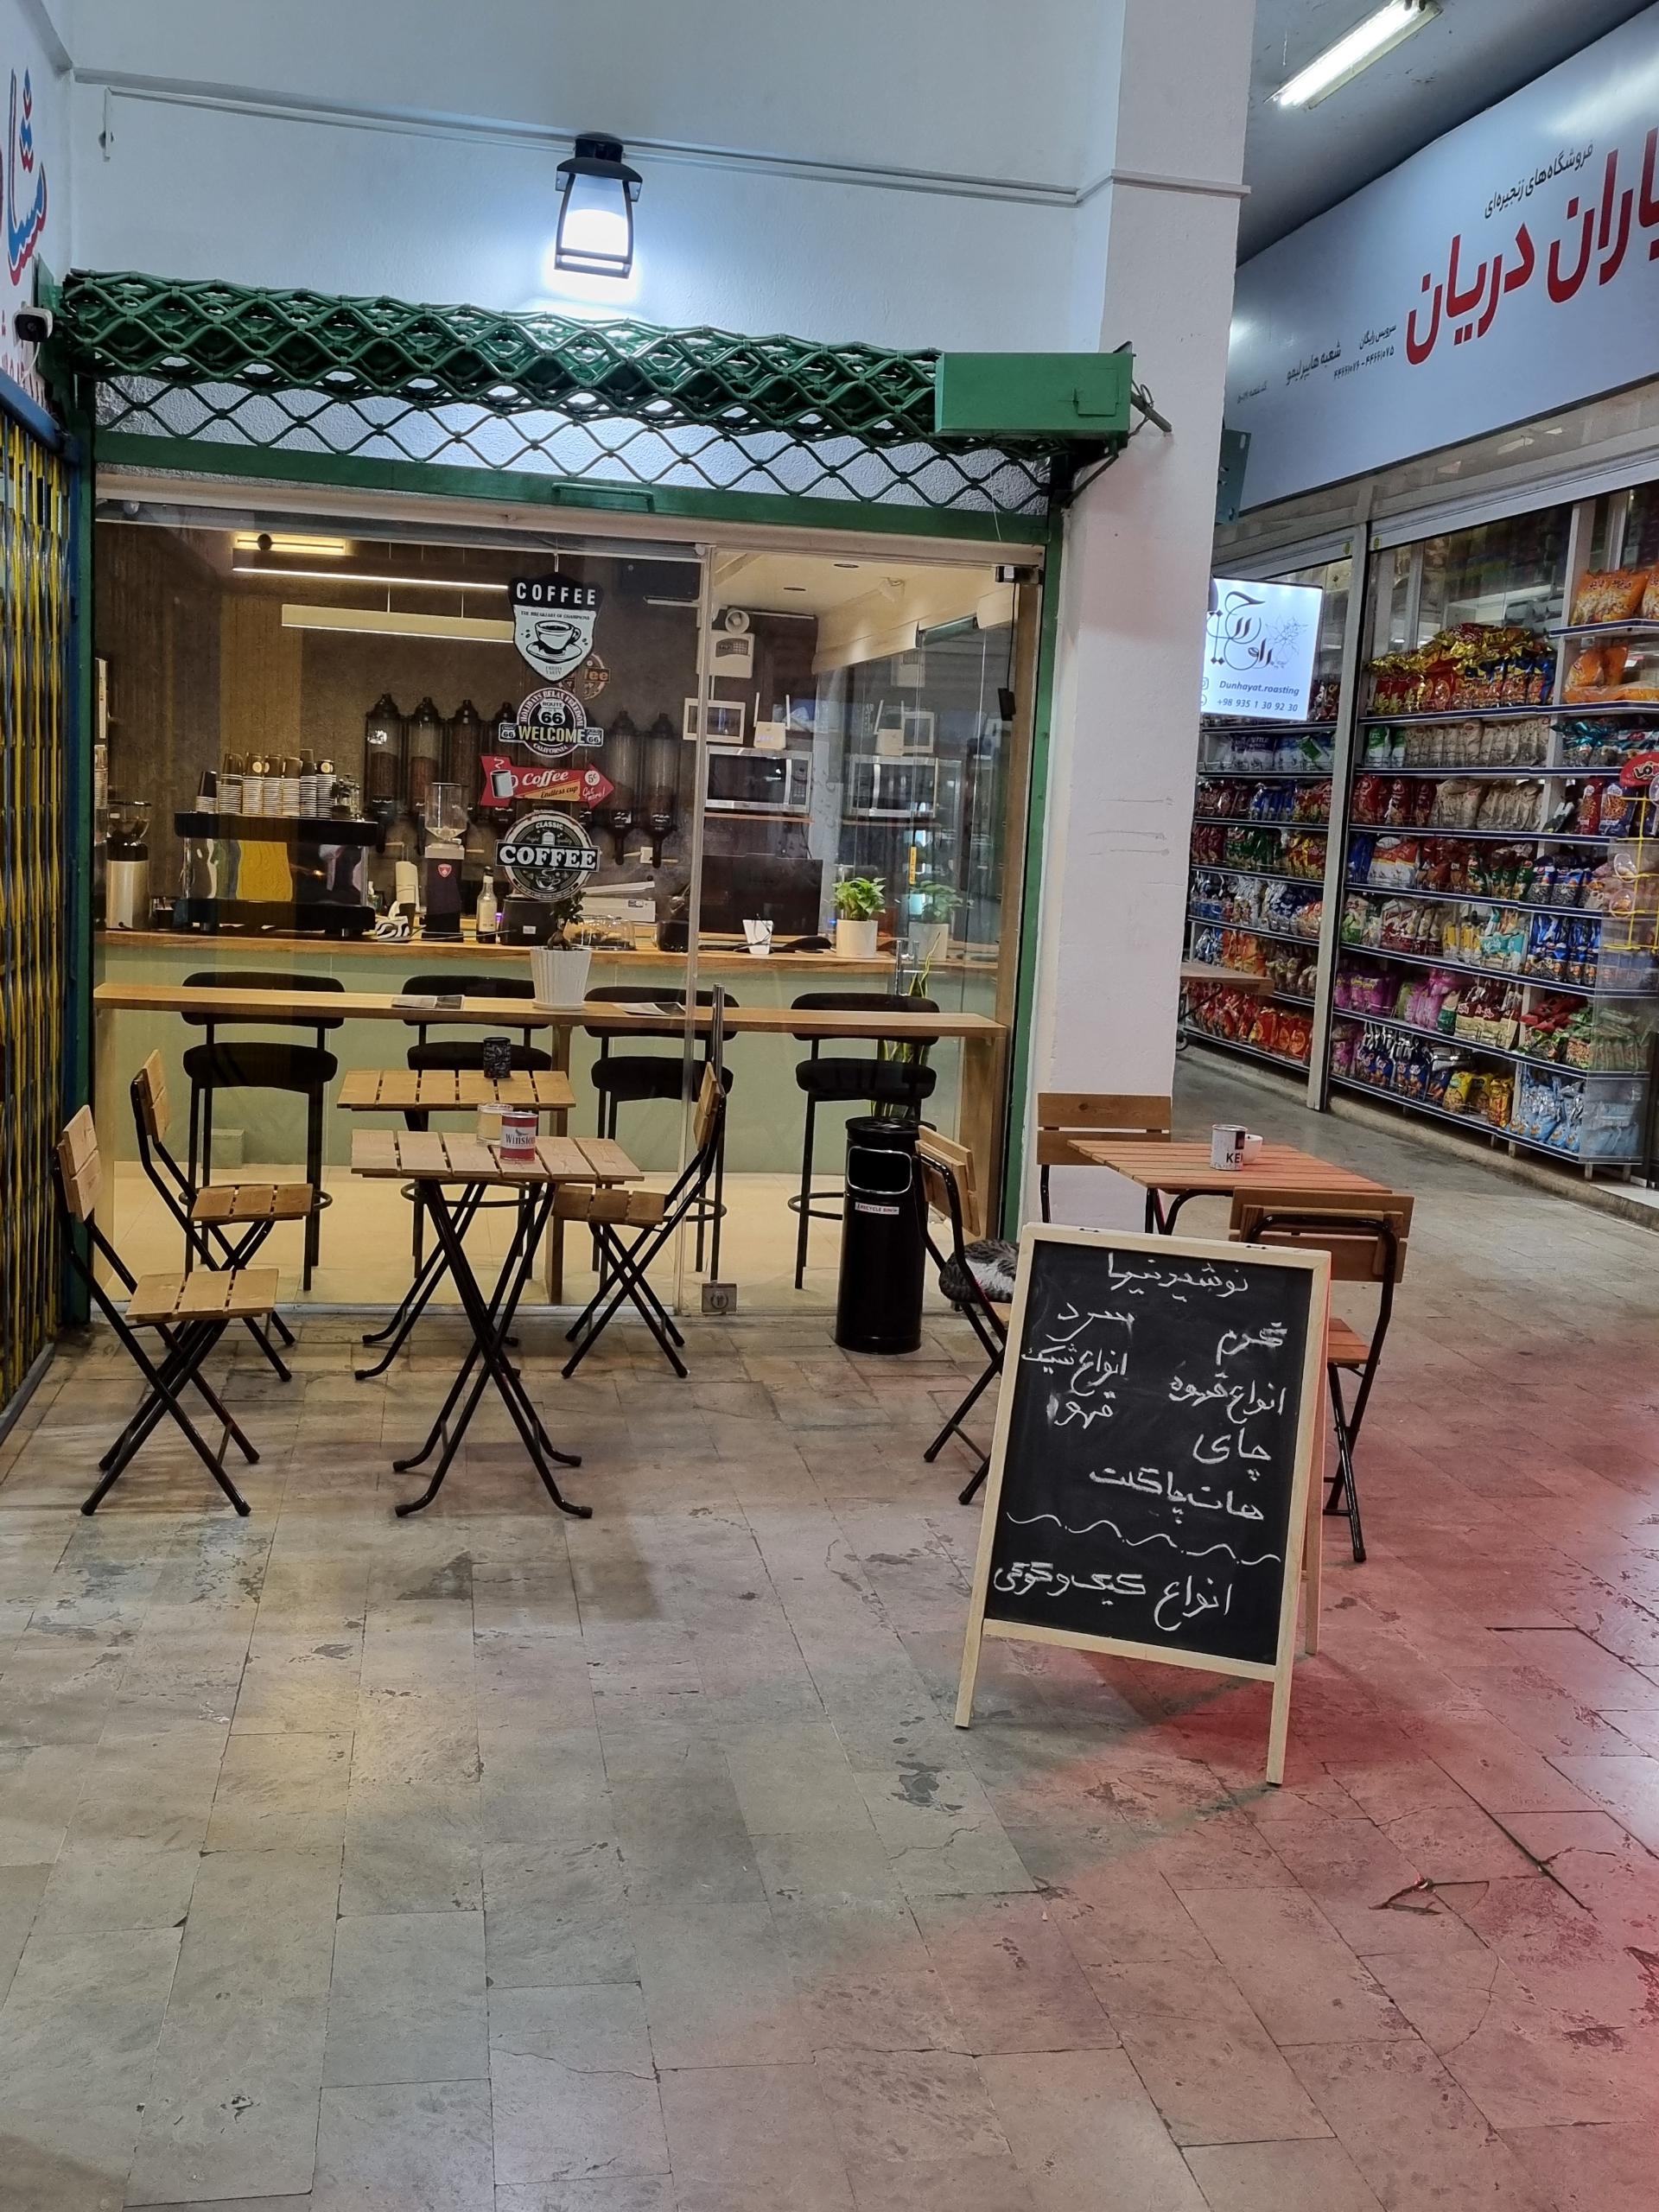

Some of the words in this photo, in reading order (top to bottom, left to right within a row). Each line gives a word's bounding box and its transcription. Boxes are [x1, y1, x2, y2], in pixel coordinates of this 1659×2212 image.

[1406, 222, 1535, 365] دریان
[1320, 340, 1342, 367] شعبه
[517, 582, 596, 605] COFFEE
[1219, 680, 1300, 697] Dunhayat.roasting
[1217, 697, 1233, 707] +98
[1236, 699, 1251, 709] 935
[1262, 702, 1272, 710] 30
[1274, 702, 1285, 711] 92
[1287, 703, 1298, 712] 30
[541, 711, 563, 724] 66
[518, 725, 586, 743] WELCOME
[533, 743, 568, 753] CALIFORNIA
[522, 770, 569, 788] Coffee
[540, 786, 565, 798] Endless
[567, 785, 579, 794] cup
[536, 821, 563, 830] CLASSIC
[499, 846, 596, 869] COFFEE
[1046, 1302, 1135, 1342] سرد
[1216, 1322, 1287, 1365] گرم
[1021, 1343, 1077, 1374] شیک
[1071, 1348, 1128, 1397] انواع
[1168, 1371, 1229, 1407] قهوه
[1227, 1380, 1287, 1424] انواع
[1192, 1427, 1272, 1482] چای
[1154, 1574, 1233, 1631] انواع
